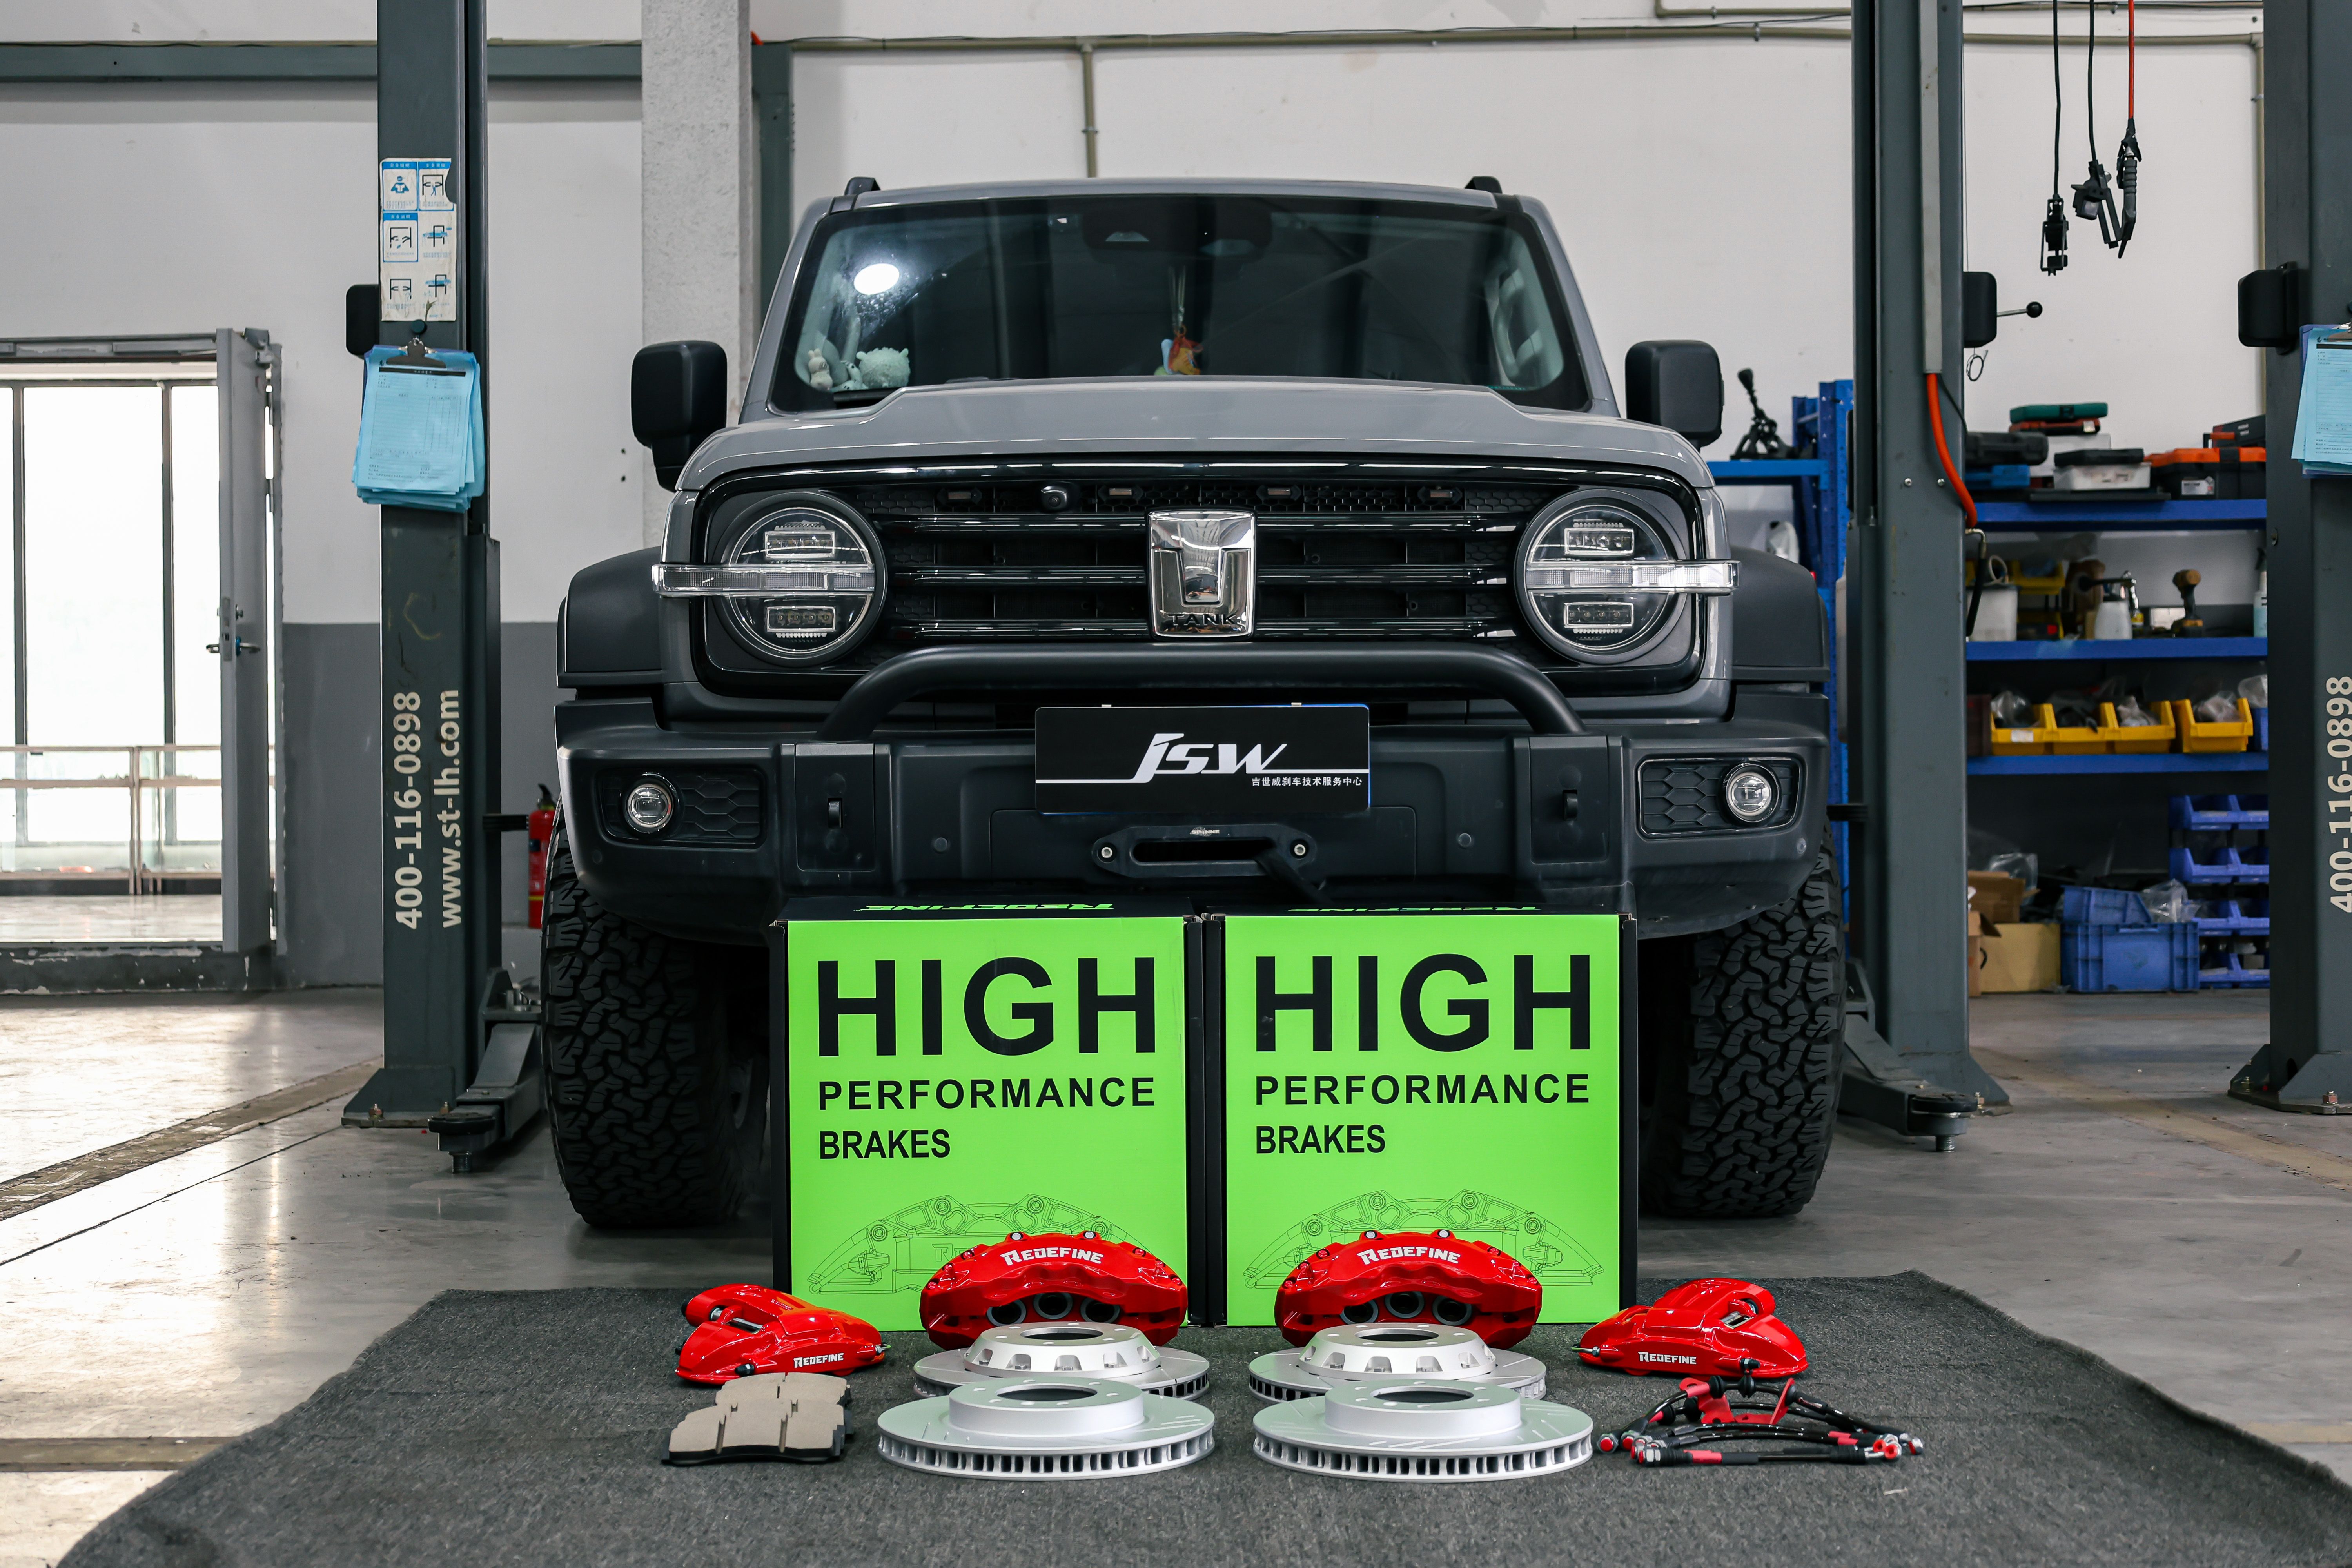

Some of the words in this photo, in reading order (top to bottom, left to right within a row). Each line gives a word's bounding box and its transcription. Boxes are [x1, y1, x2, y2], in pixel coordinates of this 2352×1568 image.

[1167, 613, 1237, 626] TANK
[1251, 776, 1363, 786] 吉世威刹车技术服务中心
[2326, 676, 2352, 913] 400-116-0898
[393, 691, 423, 929] 400-116-0898
[434, 690, 461, 928] www.st-lh.com
[818, 956, 1156, 1057] HIGH
[1255, 953, 1590, 1052] HIGH
[819, 1077, 1155, 1111] PERFORMANCE
[1256, 1074, 1589, 1105] PERFORMANCE
[819, 1129, 951, 1159] BRAKES
[1256, 1124, 1386, 1154] BRAKES
[1000, 1247, 1104, 1266] REDEFINE
[1357, 1246, 1461, 1265] REDEFINE
[793, 1352, 844, 1368] REDEFINE
[1638, 1351, 1697, 1365] REDEFINE
